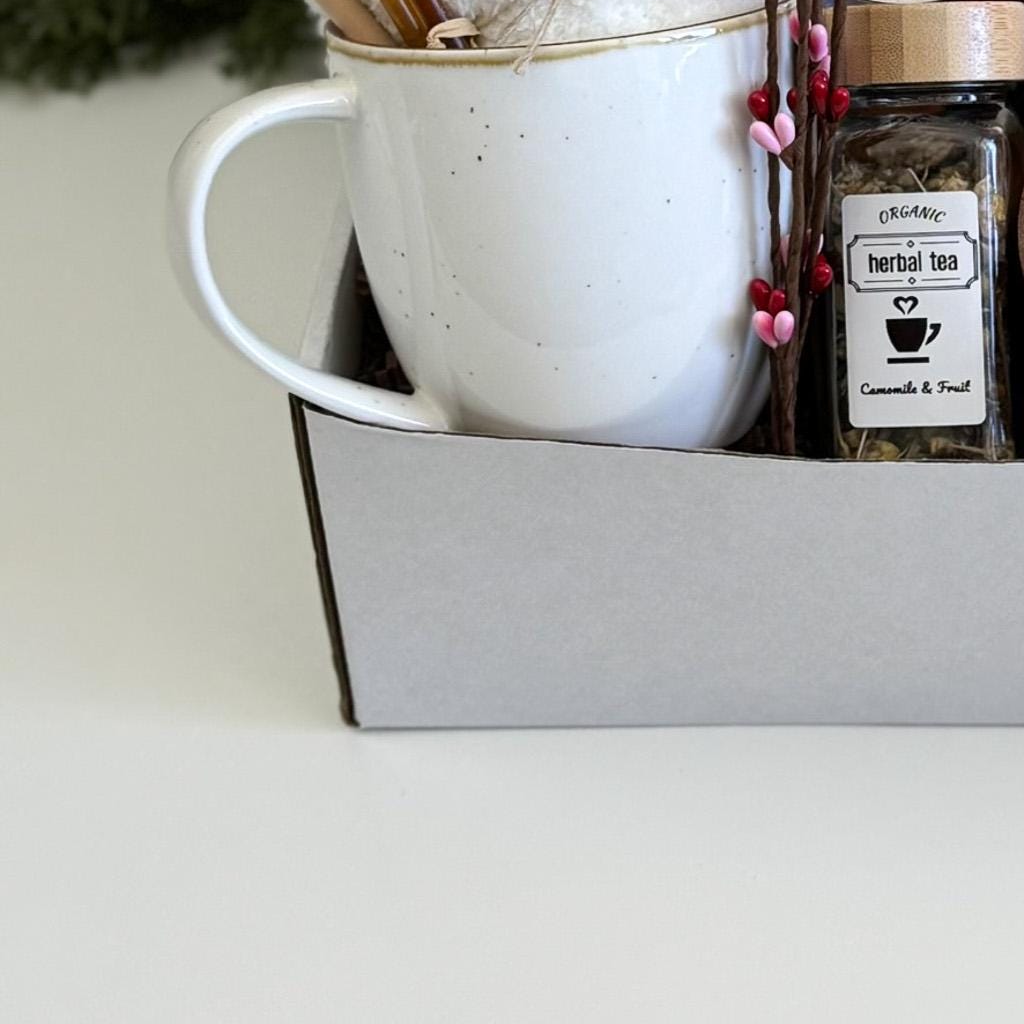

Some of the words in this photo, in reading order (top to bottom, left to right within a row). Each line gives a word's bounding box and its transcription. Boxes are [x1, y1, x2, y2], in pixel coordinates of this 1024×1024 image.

[879, 205, 946, 224] ORGANIC
[868, 251, 922, 274] herbal
[929, 251, 958, 272] tea
[860, 380, 917, 395] Camomile
[921, 381, 933, 394] &
[936, 380, 971, 394] Fruit
